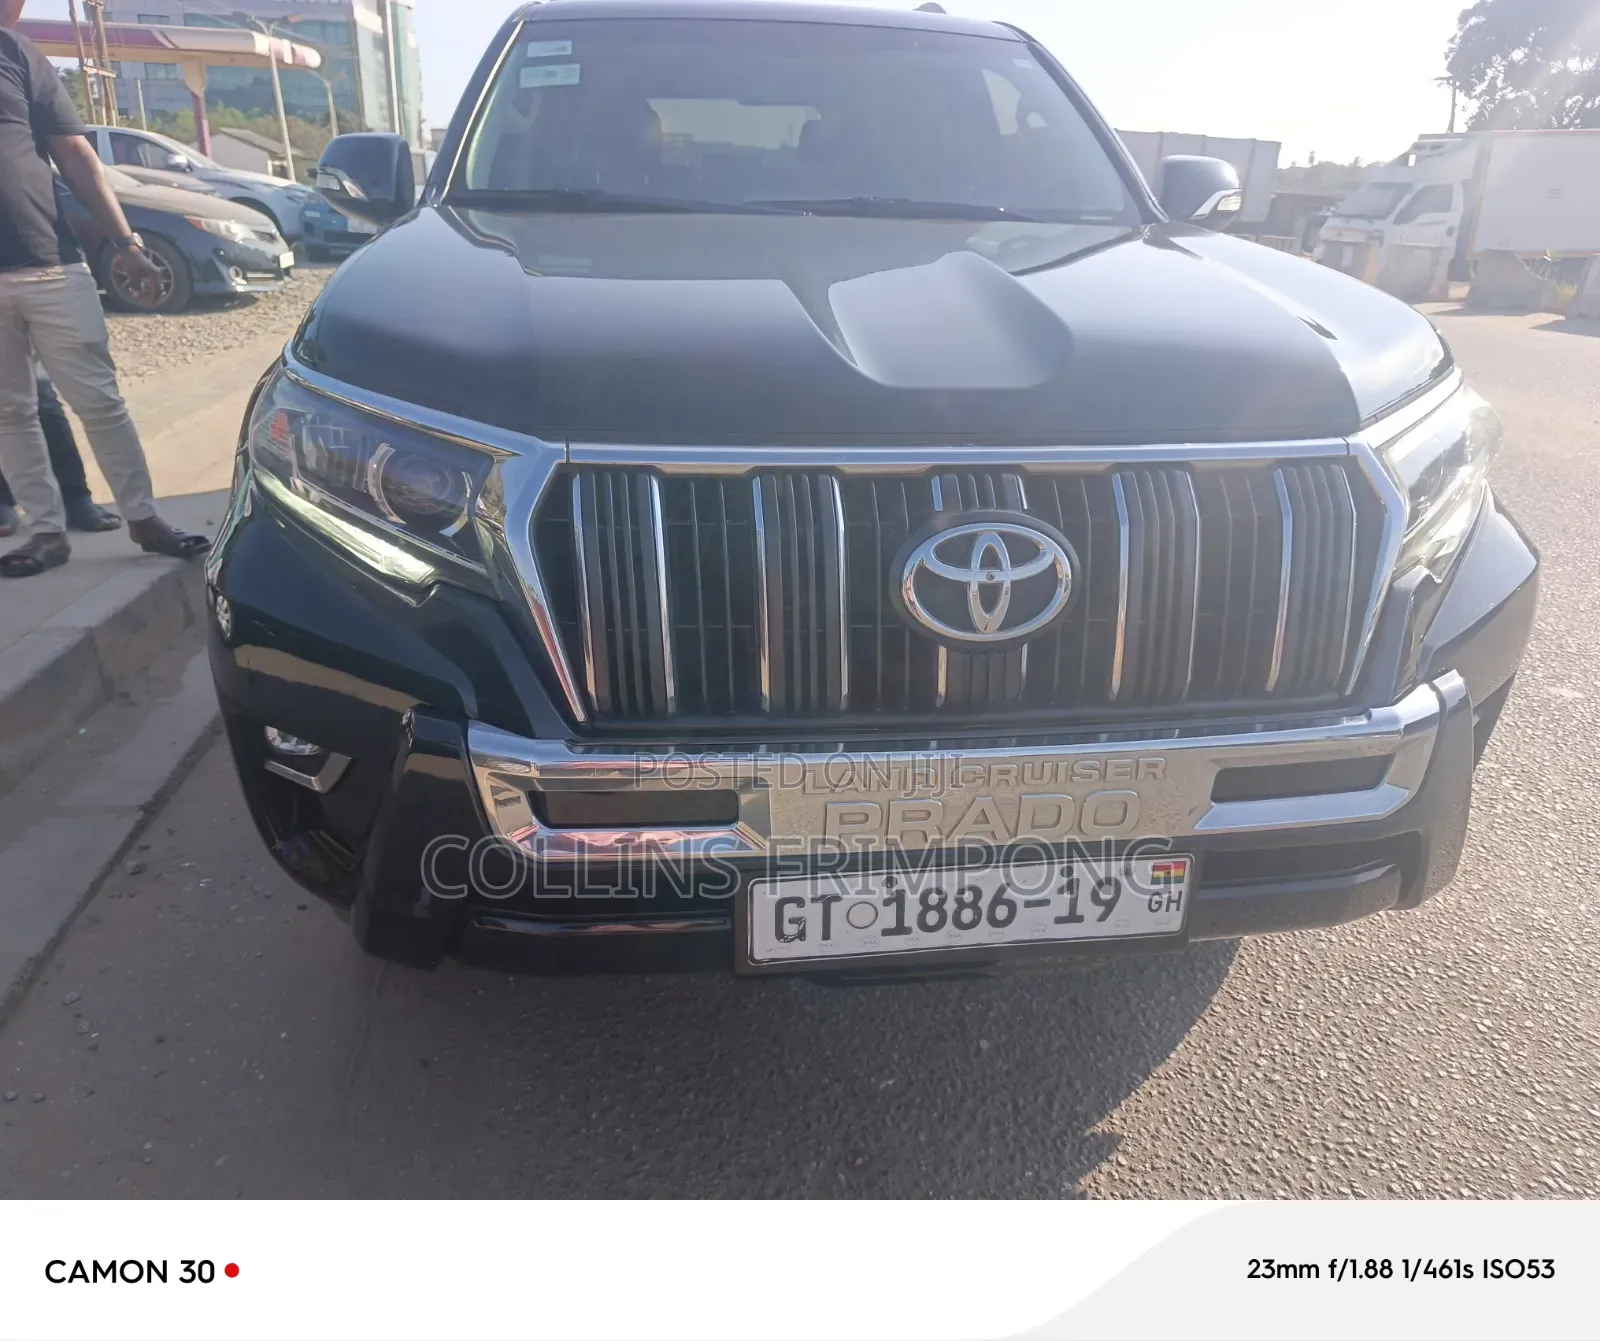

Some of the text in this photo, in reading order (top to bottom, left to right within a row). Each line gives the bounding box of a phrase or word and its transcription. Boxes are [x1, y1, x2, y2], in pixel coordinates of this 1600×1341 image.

[954, 756, 1167, 790] CRUISER
[824, 789, 1141, 849] PRADO
[774, 876, 1122, 943] GT 1886-19
[1147, 890, 1184, 913] GH
